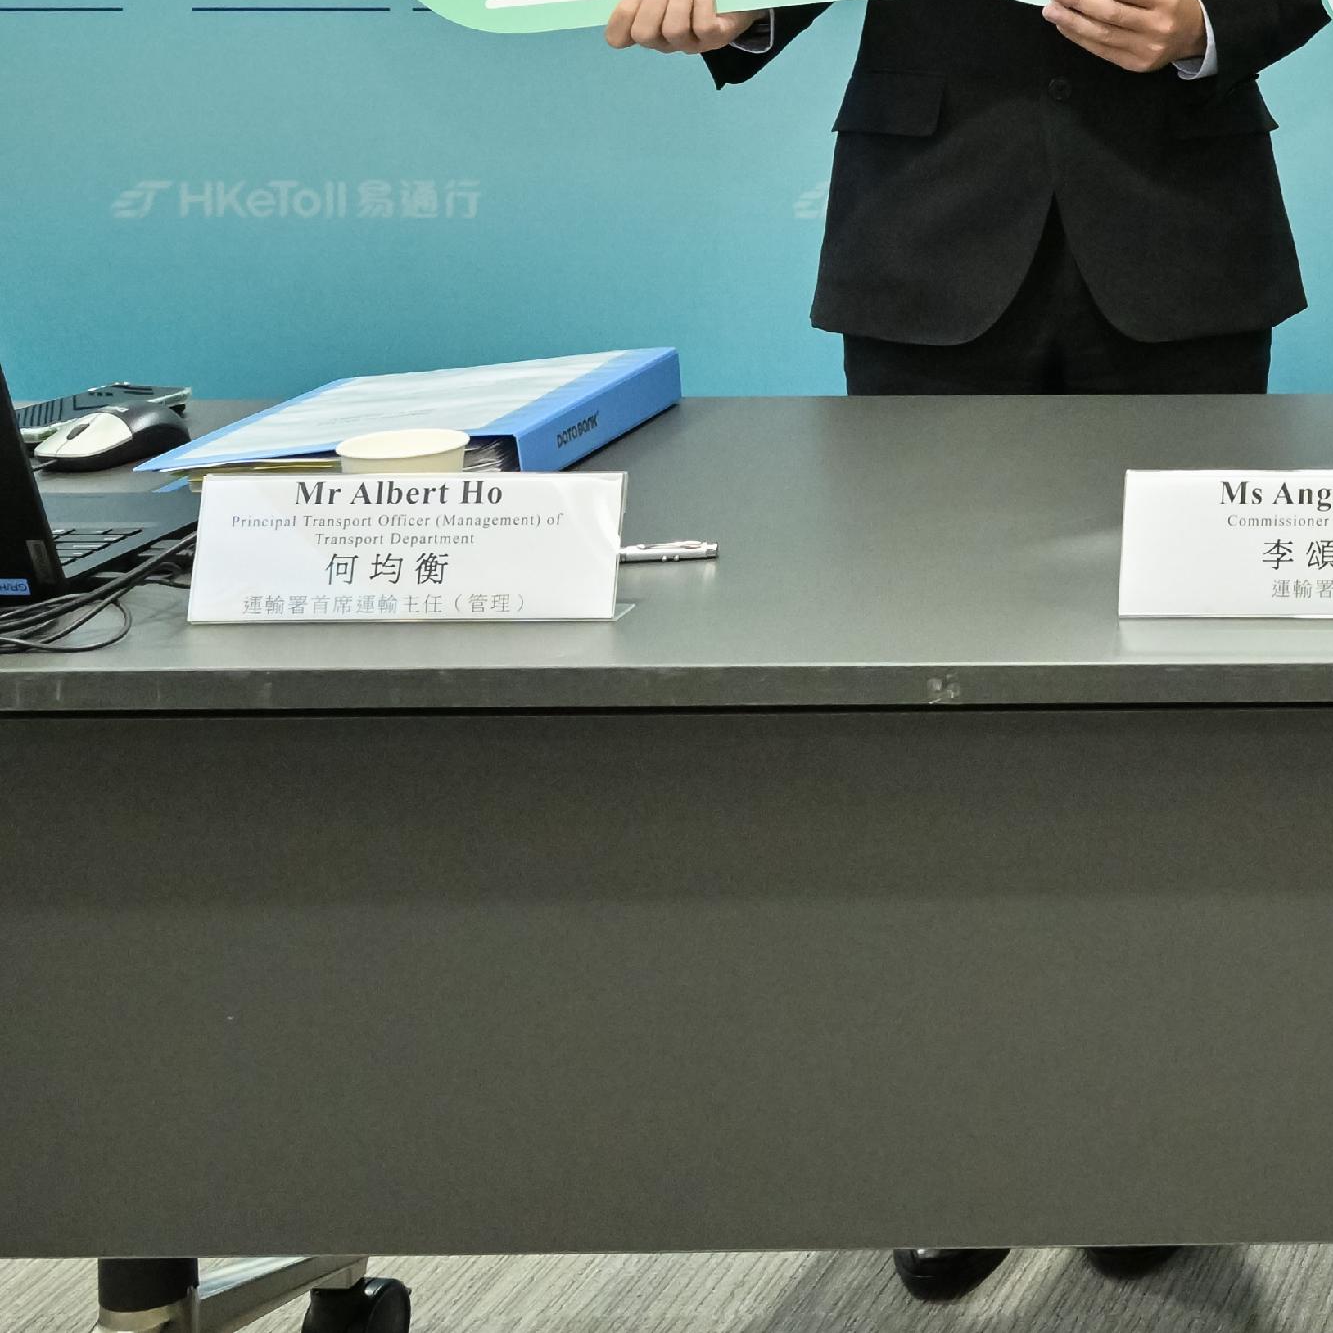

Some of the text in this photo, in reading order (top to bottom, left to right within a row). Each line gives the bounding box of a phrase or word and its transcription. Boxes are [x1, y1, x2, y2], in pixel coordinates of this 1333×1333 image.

[178, 179, 347, 219] HKeToll
[357, 179, 482, 219] 易通行
[295, 479, 503, 506] Mr Albert Ho
[1219, 481, 1263, 505] Ms
[232, 512, 564, 530] Principal Transport Officer (Management) of
[1227, 514, 1330, 528] Commissioner
[315, 532, 476, 547] Transport Department
[325, 552, 449, 585] 何均衡
